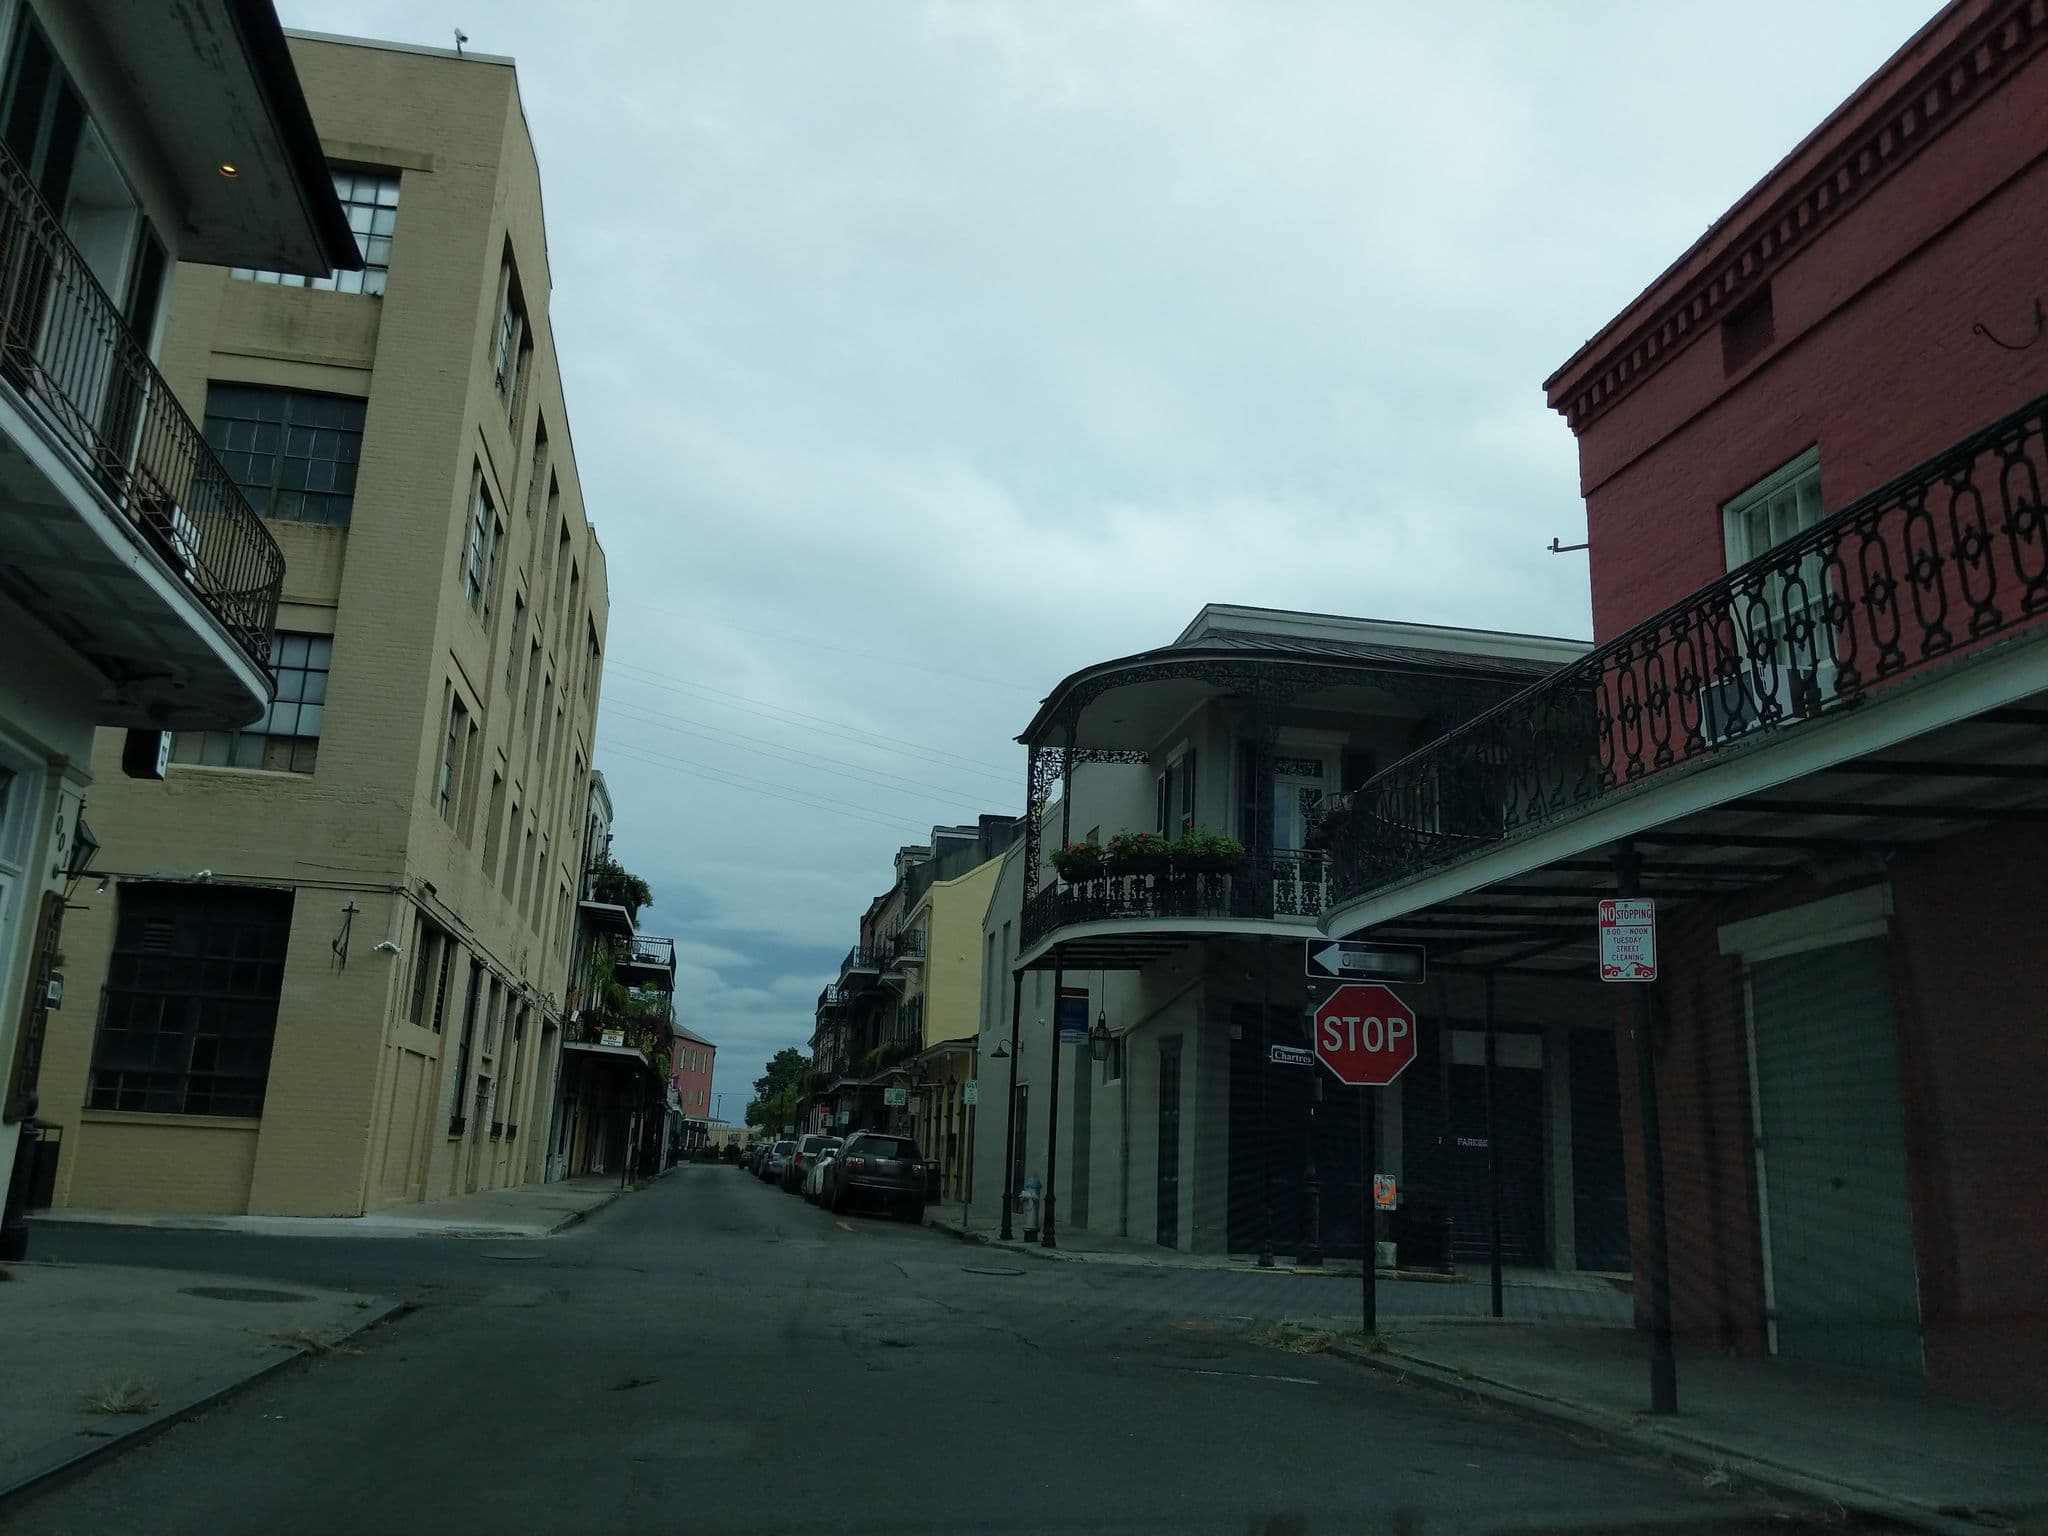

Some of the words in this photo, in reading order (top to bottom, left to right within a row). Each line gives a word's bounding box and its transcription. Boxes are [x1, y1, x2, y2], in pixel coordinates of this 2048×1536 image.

[1601, 906, 1616, 922] NO
[1616, 908, 1652, 920] STOPPING
[1322, 1015, 1409, 1053] STOP
[1274, 1050, 1312, 1063] Chartres
